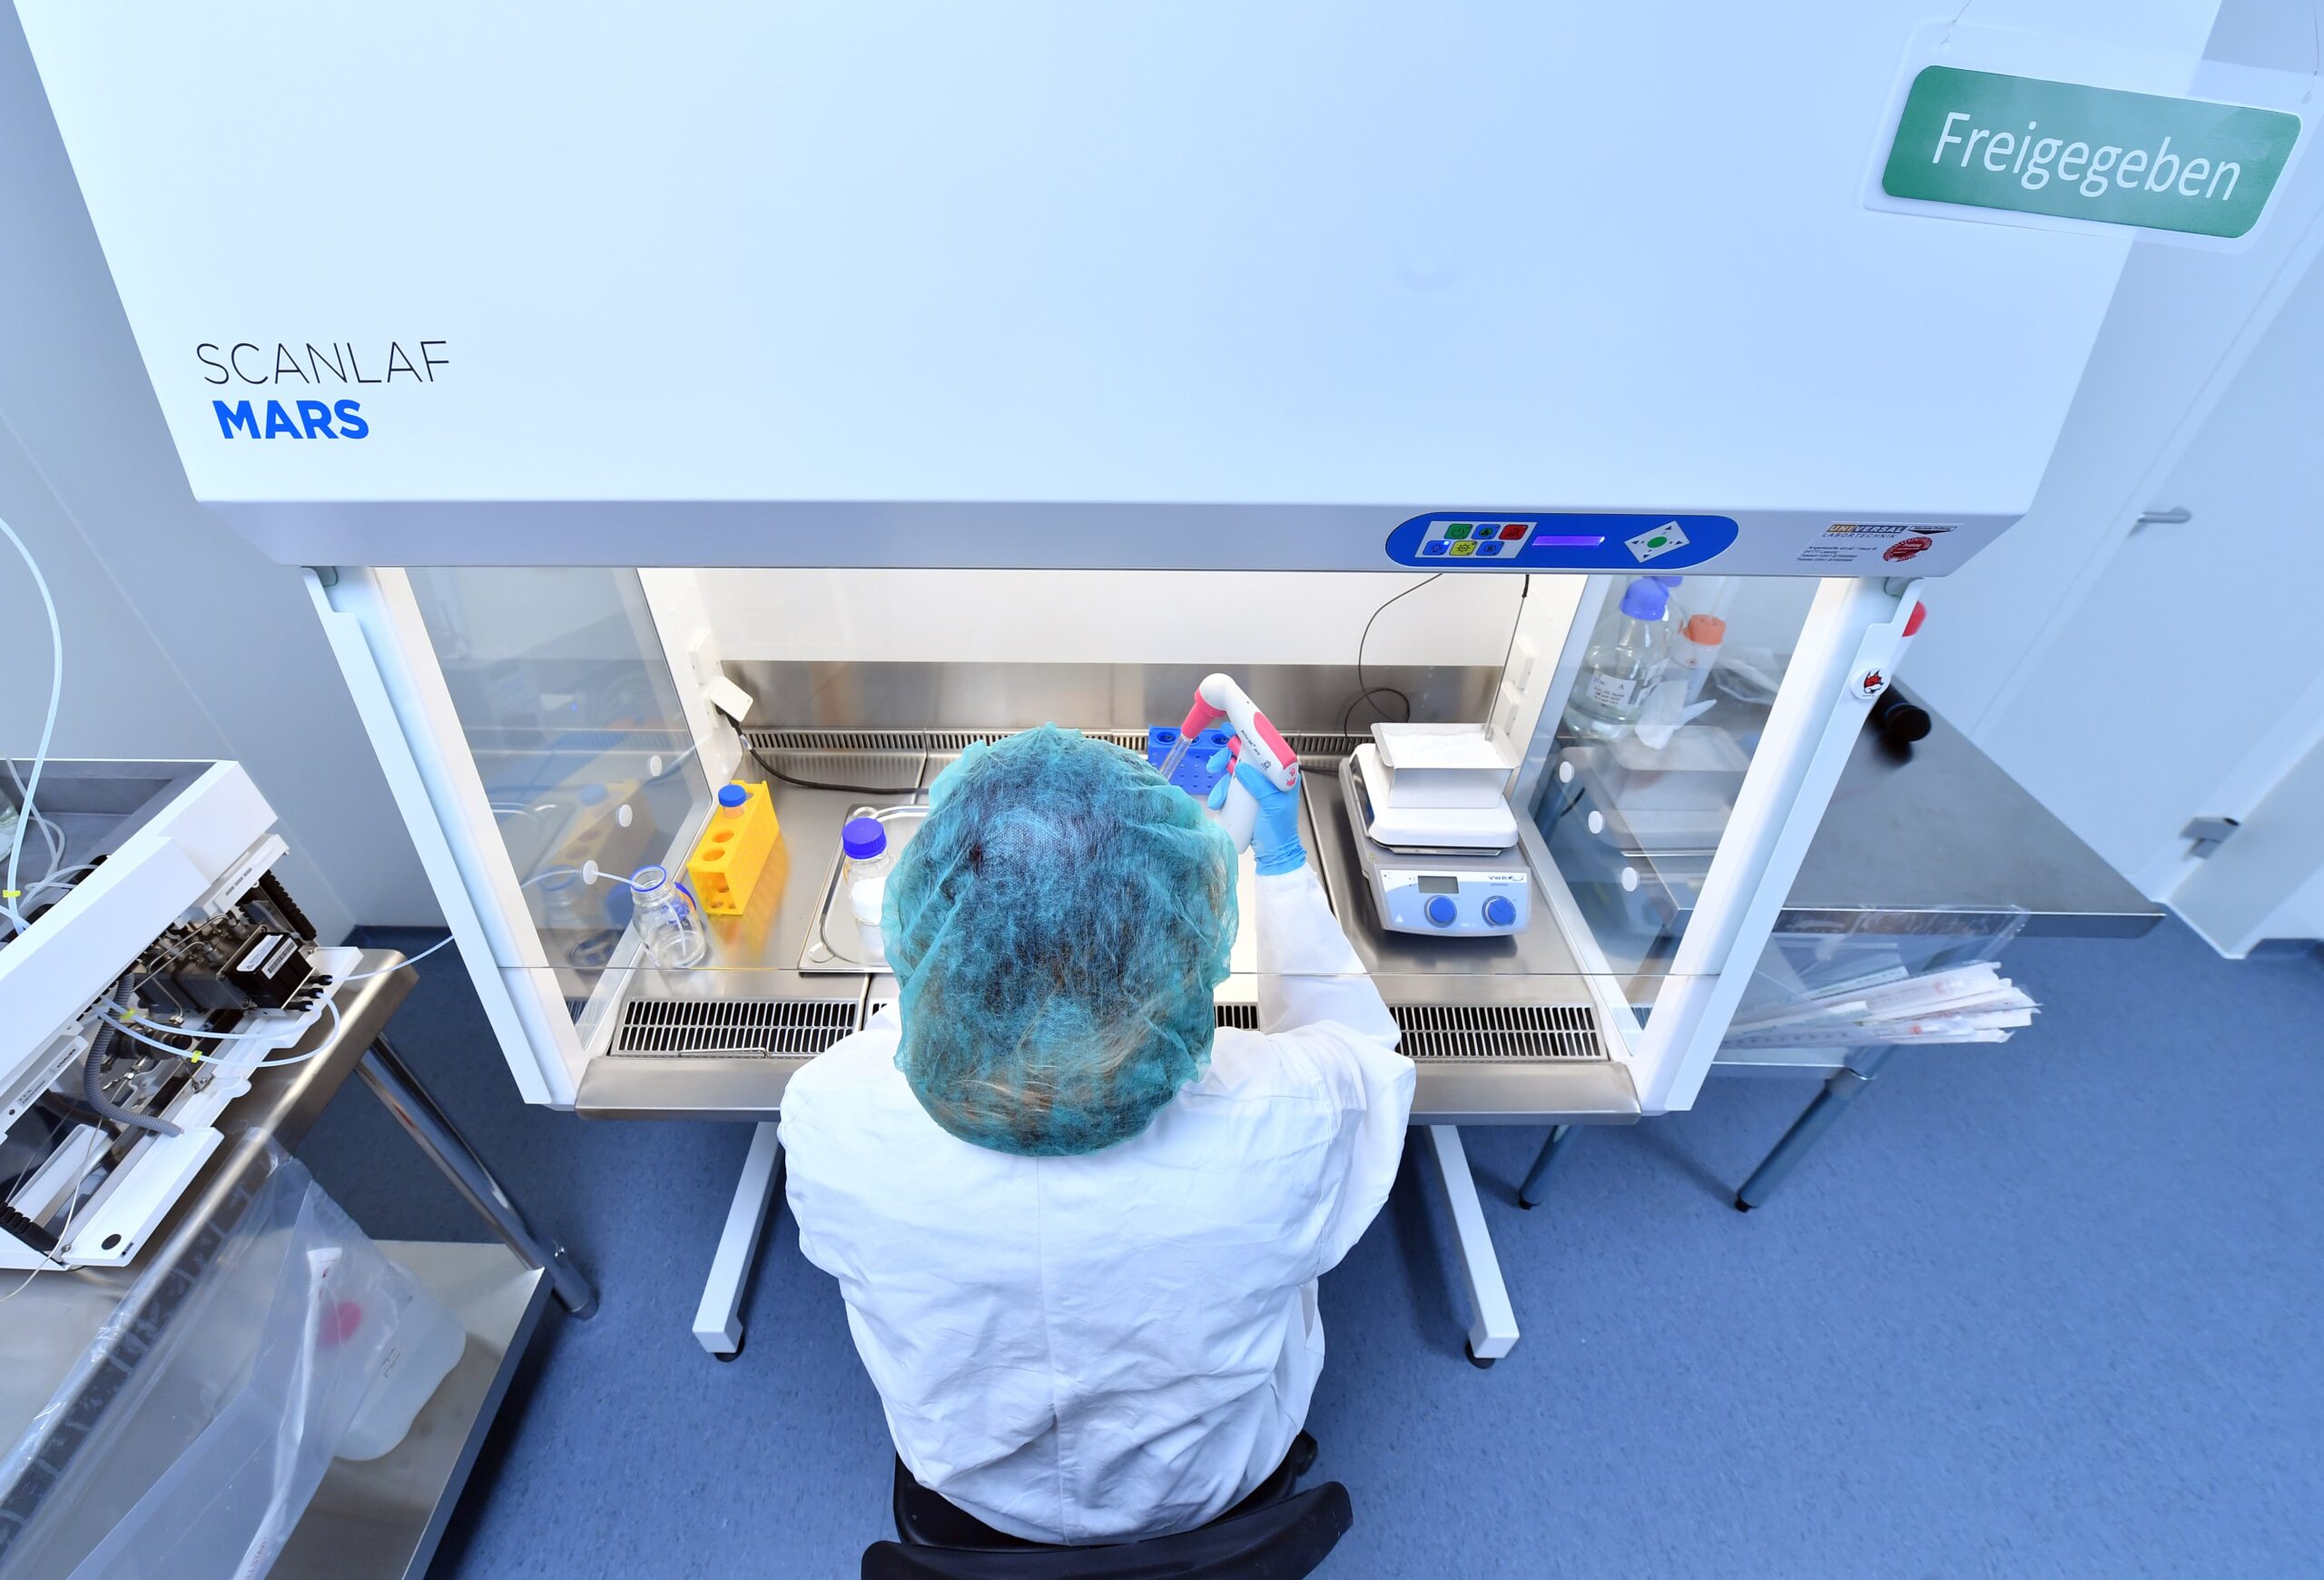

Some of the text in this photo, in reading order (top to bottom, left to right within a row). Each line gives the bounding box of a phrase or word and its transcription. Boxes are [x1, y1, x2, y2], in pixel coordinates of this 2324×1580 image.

[1932, 111, 2241, 202] Freigegeben
[196, 341, 449, 385] SCANLAF
[212, 399, 369, 439] MARS
[1828, 525, 1904, 533] UNIVERSAL
